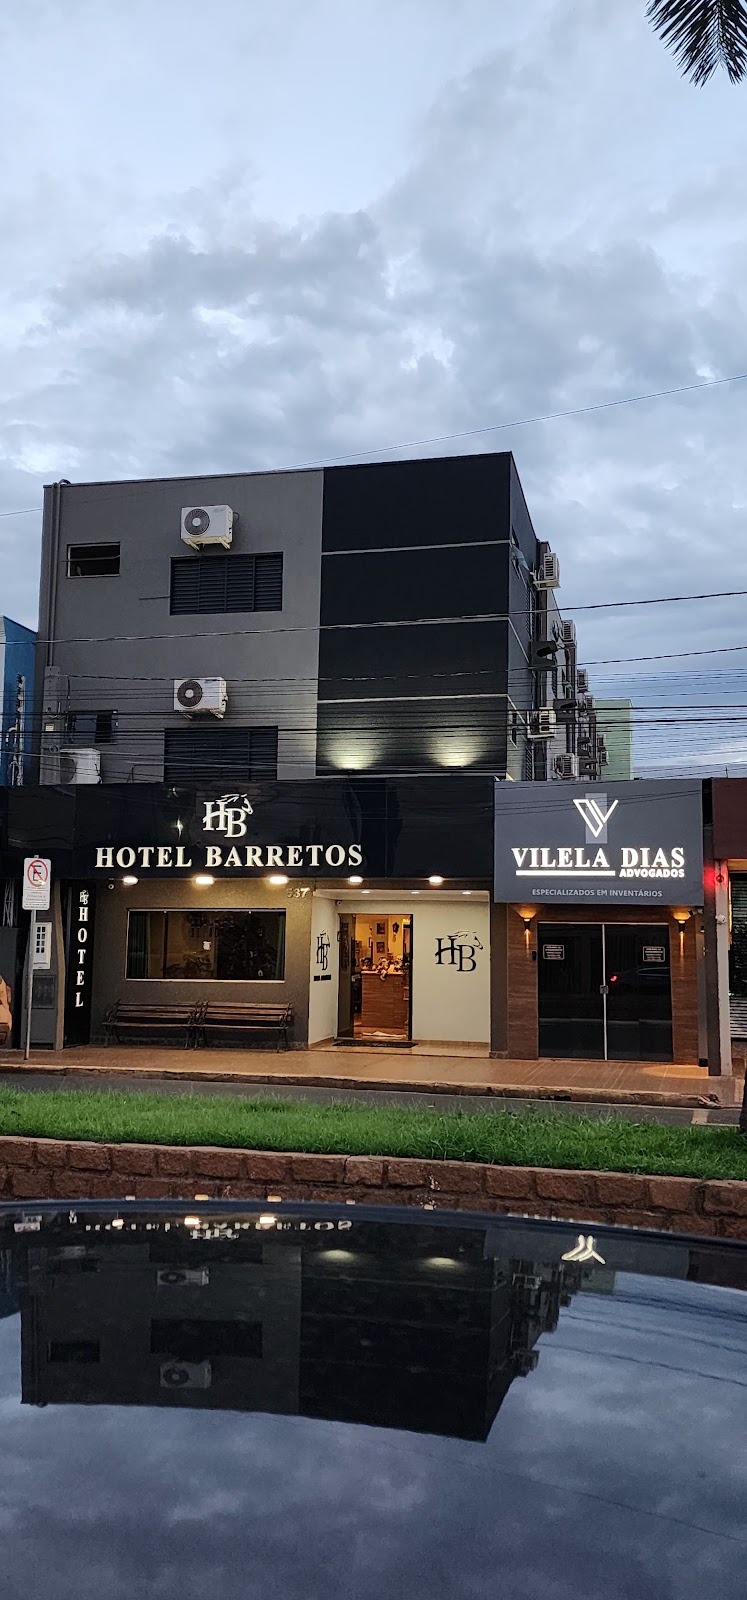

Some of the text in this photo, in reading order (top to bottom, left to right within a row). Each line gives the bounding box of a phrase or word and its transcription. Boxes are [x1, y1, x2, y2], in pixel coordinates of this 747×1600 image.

[202, 800, 248, 838] HB
[94, 844, 364, 868] HOTEL BARRETOS
[511, 847, 685, 868] VILELA DIAS
[619, 868, 685, 878] ADVOGADOS
[532, 887, 663, 898] ESPECIALIZADOS EM INVENTÁRIOS
[74, 906, 89, 1008] HOTEL
[434, 937, 477, 972] HB
